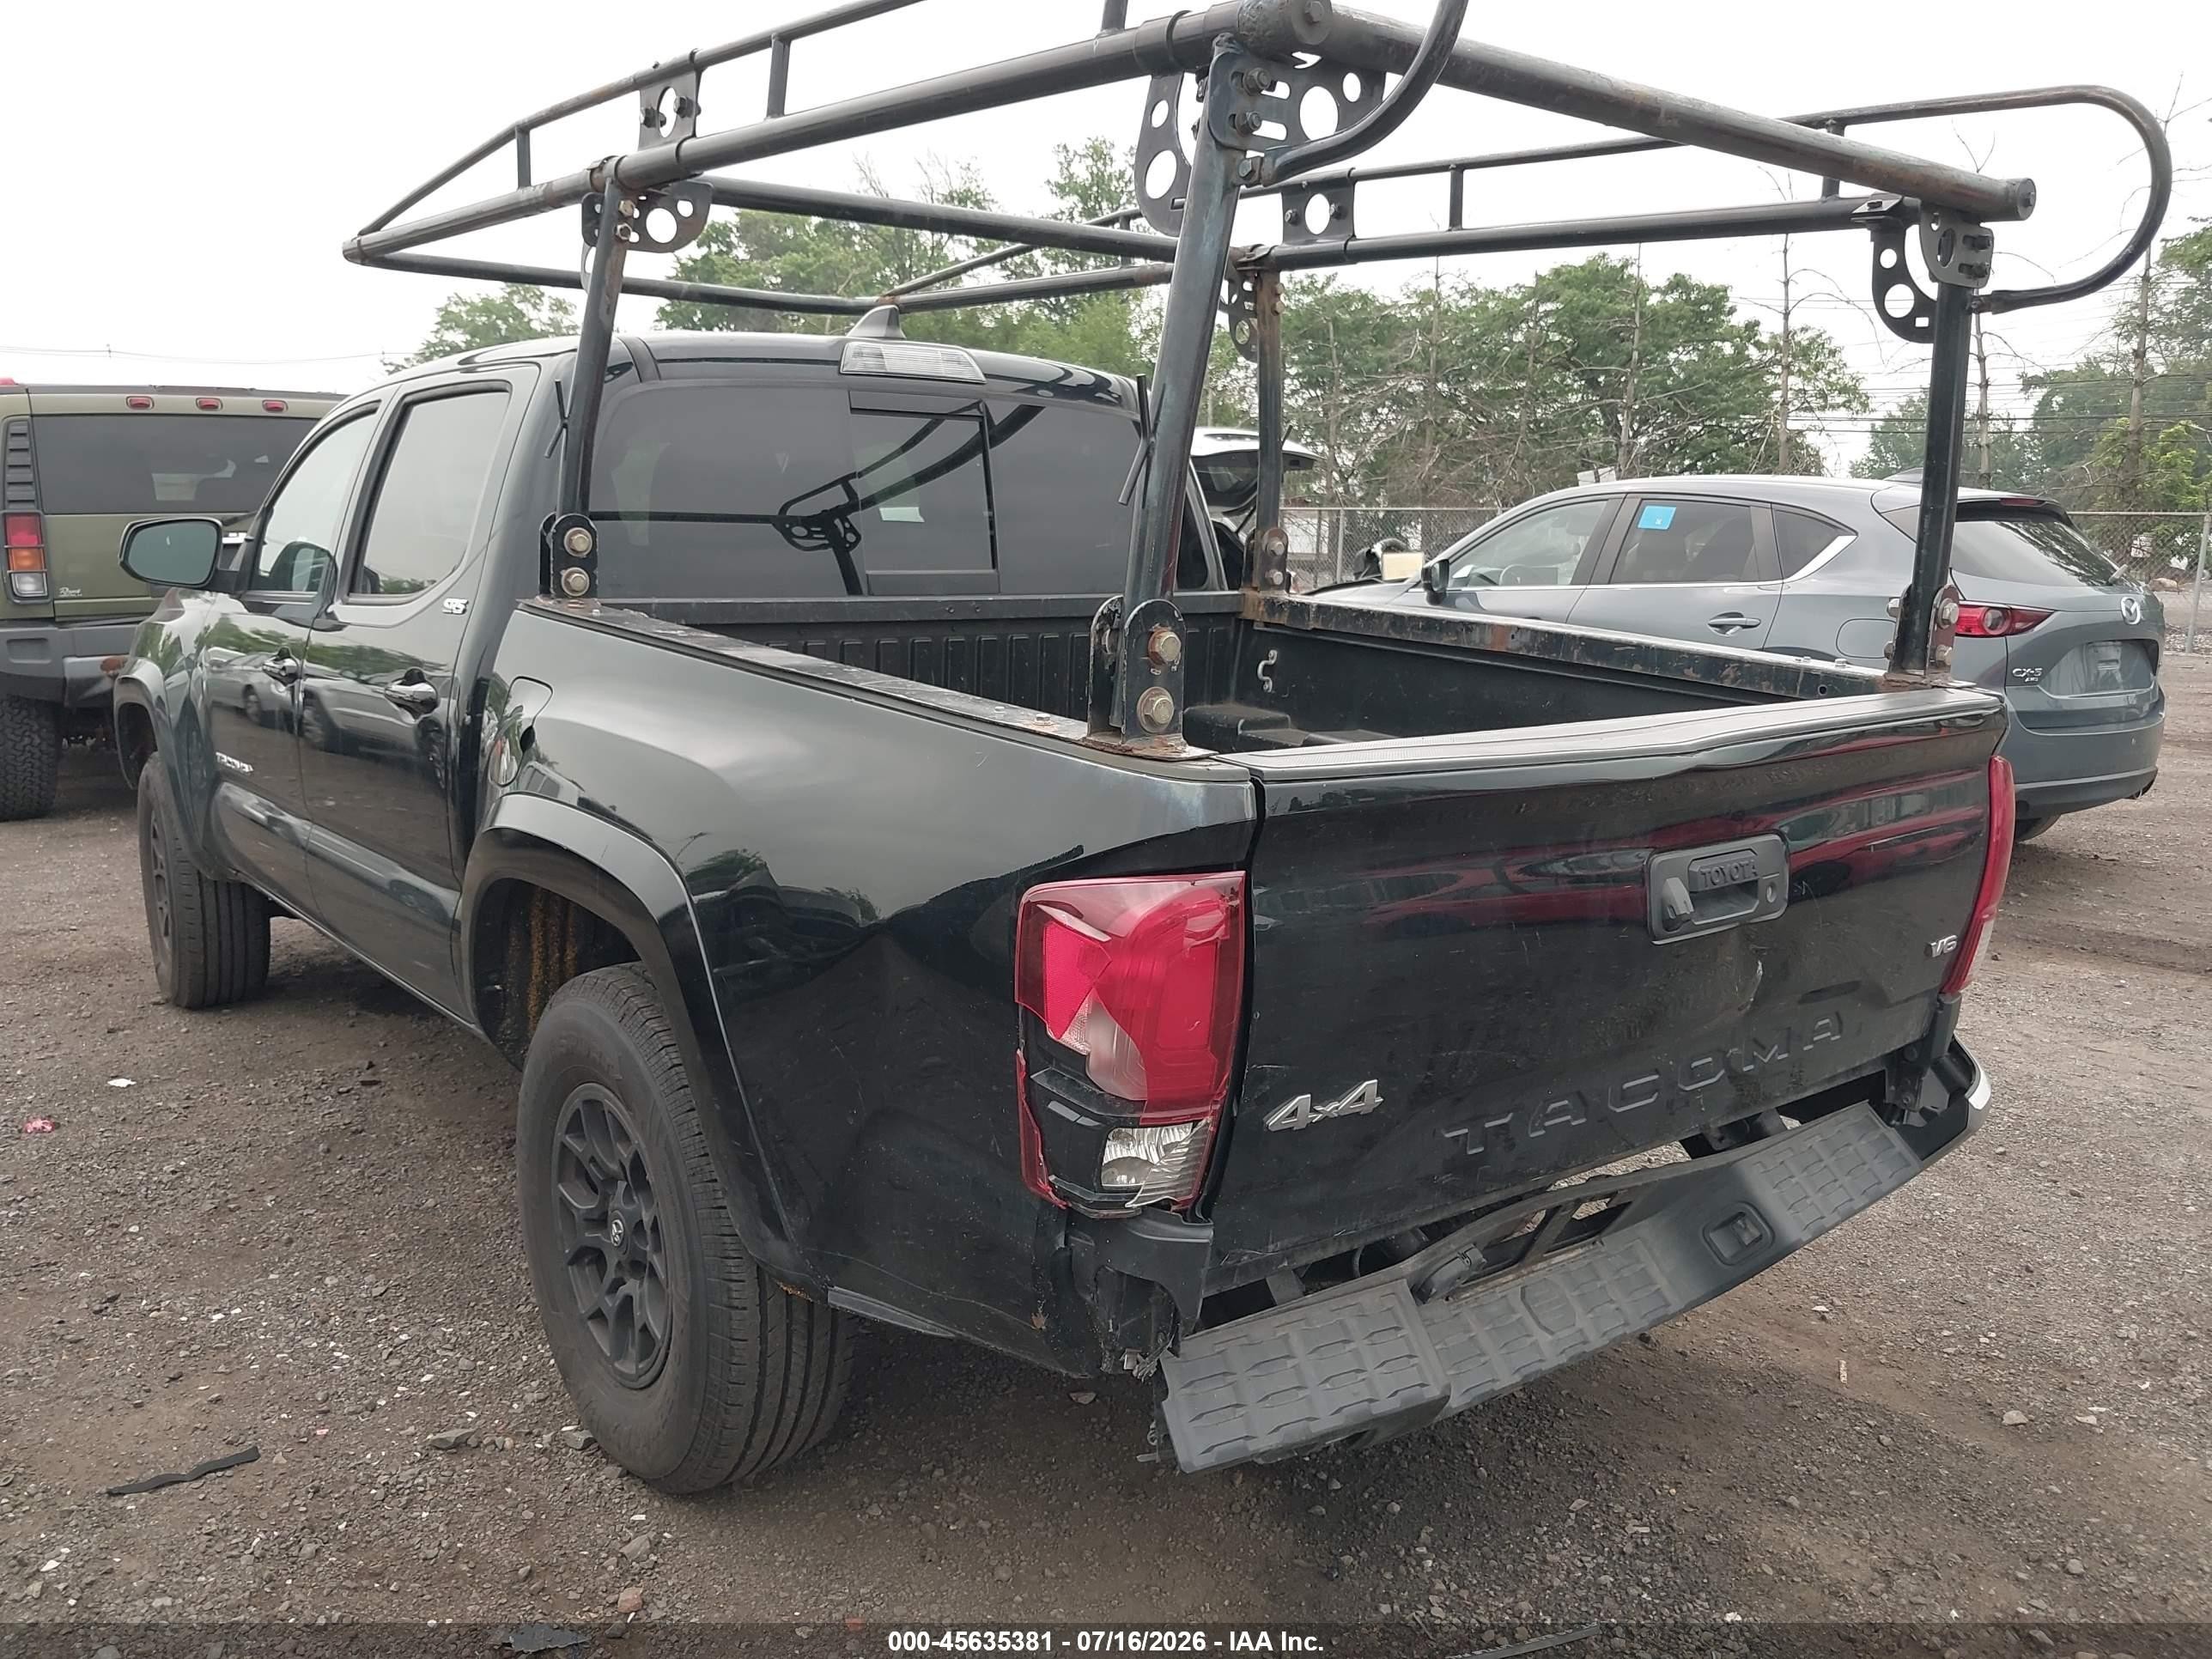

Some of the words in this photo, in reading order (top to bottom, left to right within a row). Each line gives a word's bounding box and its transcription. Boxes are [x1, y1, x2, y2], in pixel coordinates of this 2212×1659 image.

[1699, 859, 1759, 888] TOYOTA
[1929, 934, 1958, 958] V6
[1441, 1011, 1844, 1156] TACOMA
[1263, 1079, 1384, 1133] 4x4
